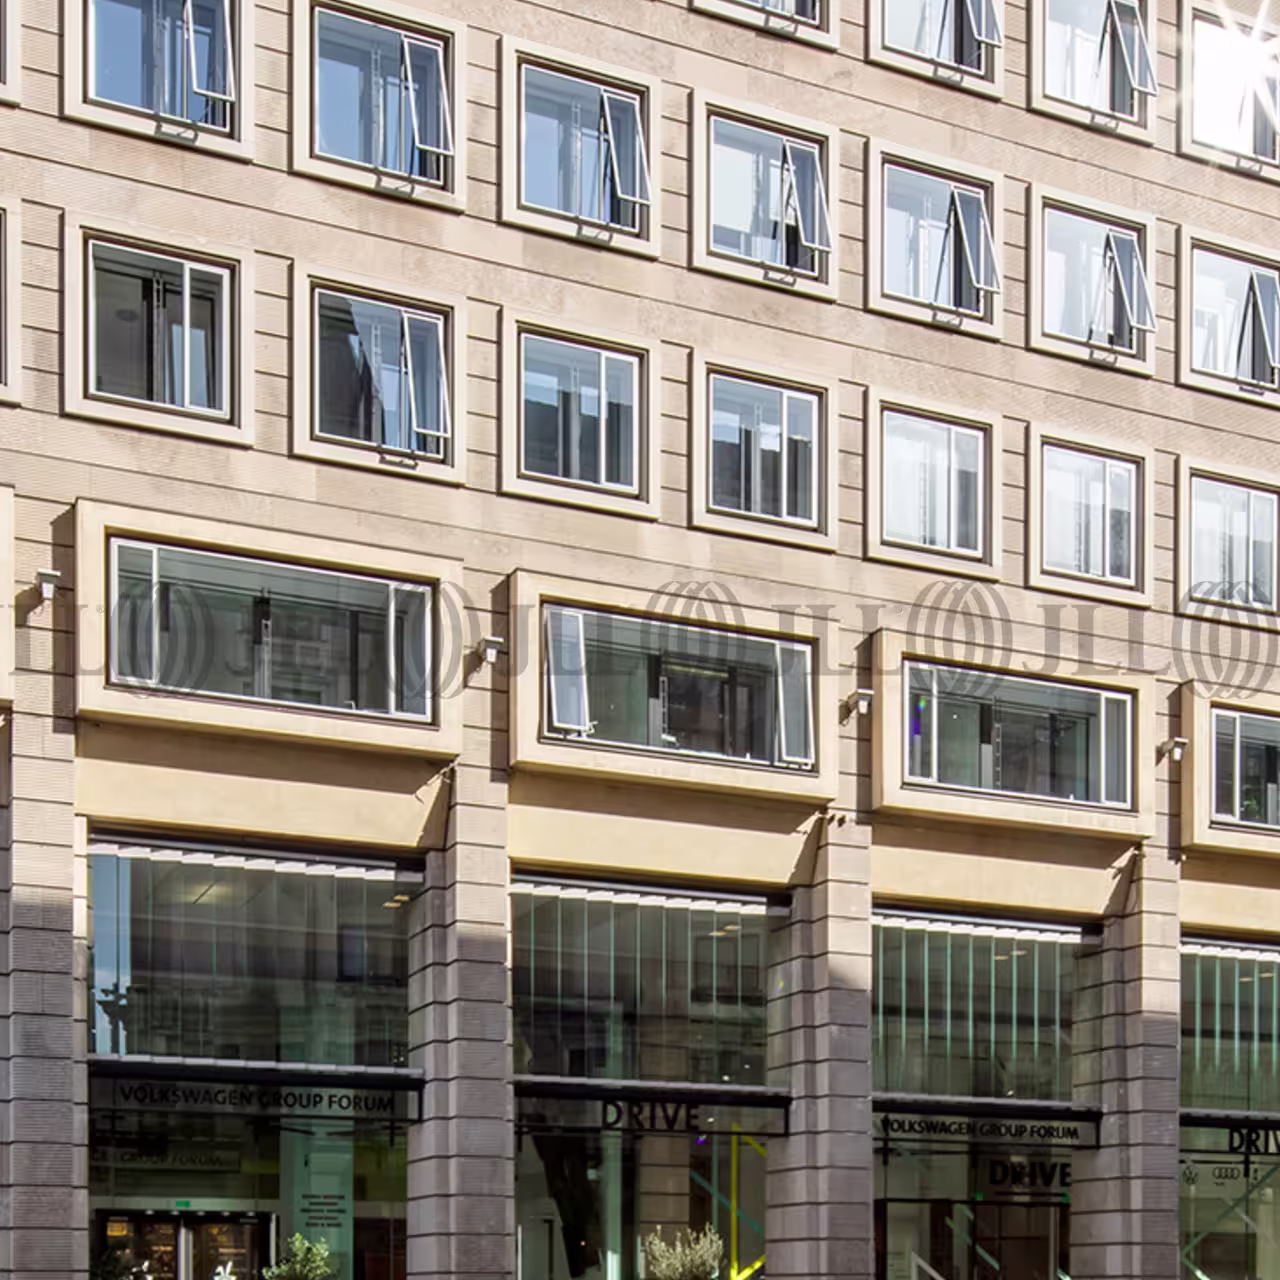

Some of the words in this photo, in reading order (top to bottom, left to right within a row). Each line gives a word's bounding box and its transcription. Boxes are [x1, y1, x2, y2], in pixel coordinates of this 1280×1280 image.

[119, 1085, 252, 1105] VOLKSWAGEN
[258, 1089, 322, 1109] GROUP
[328, 1093, 395, 1112] FORUM
[602, 1101, 700, 1131] DRIVE
[980, 1123, 1026, 1137] GROUP
[1030, 1125, 1079, 1140] FORUM
[990, 1160, 1072, 1188] DRIVE
